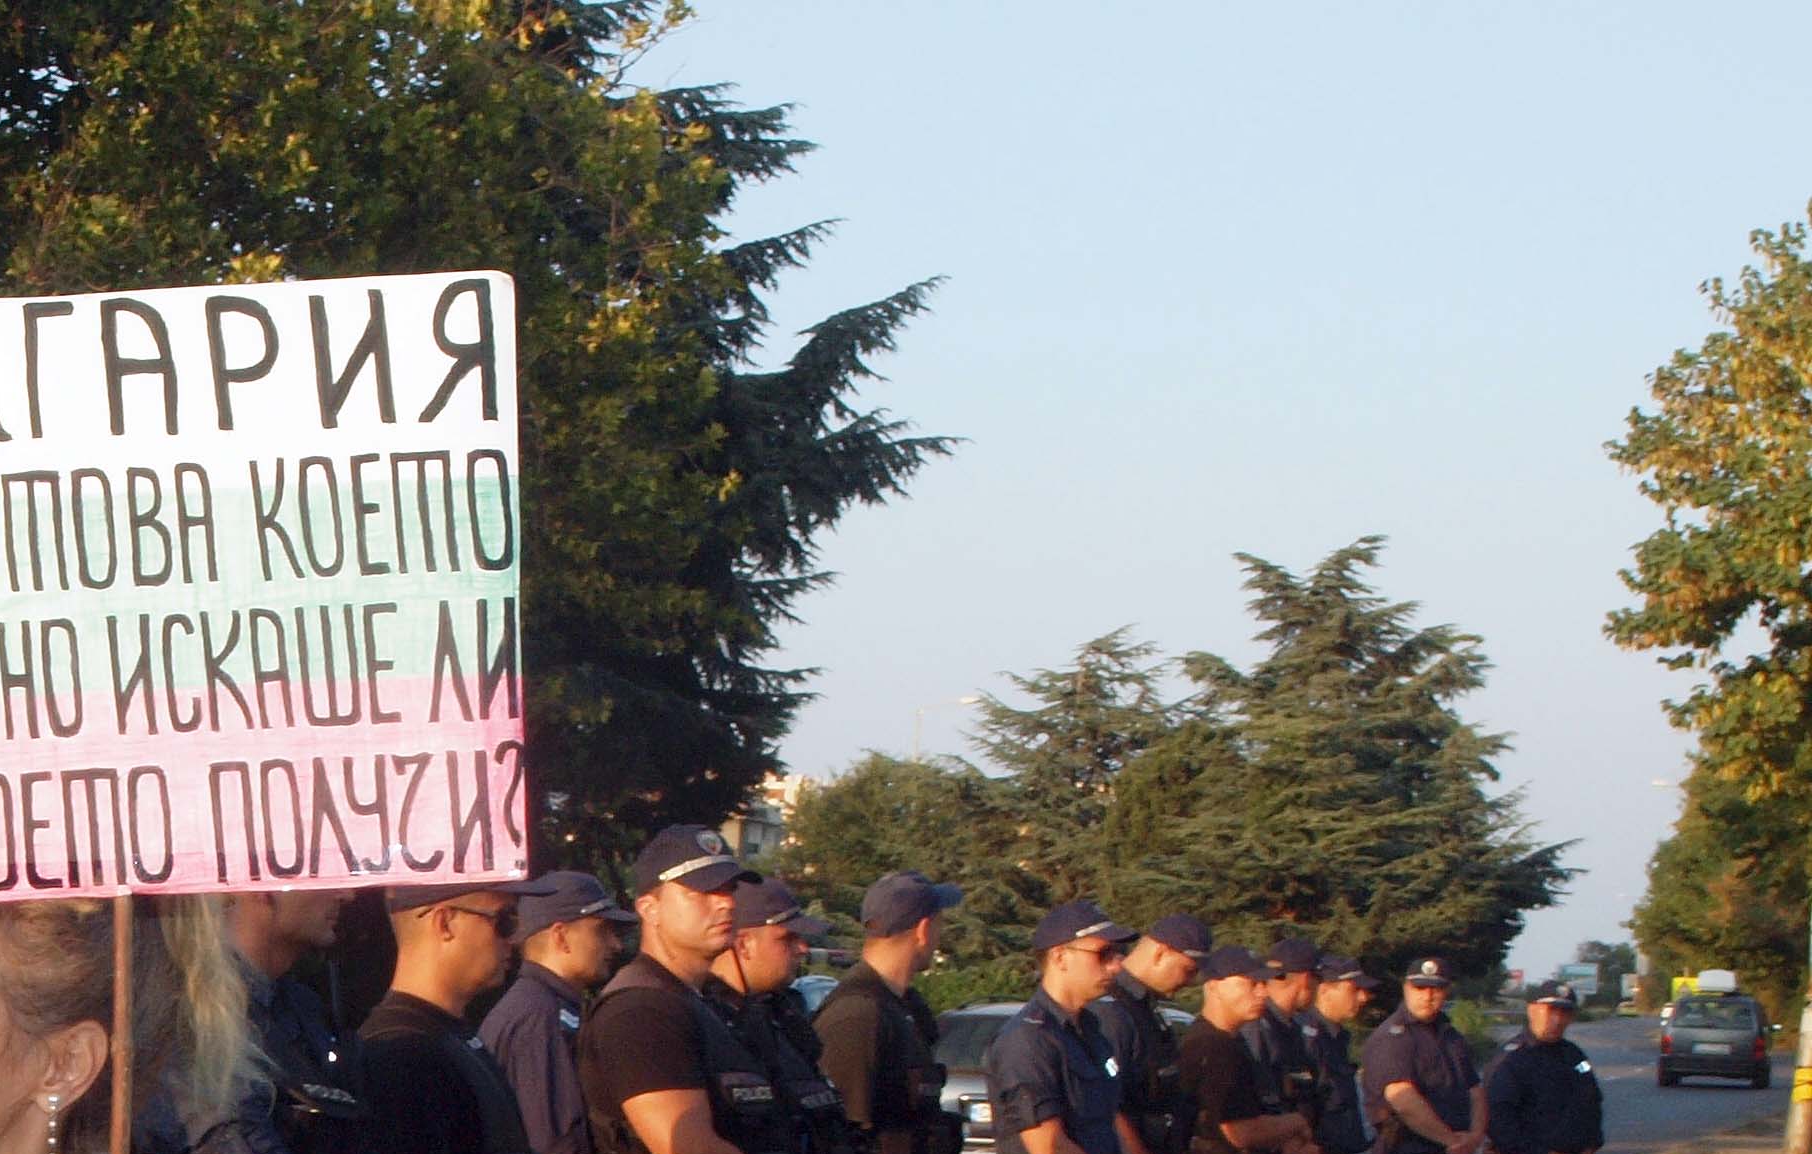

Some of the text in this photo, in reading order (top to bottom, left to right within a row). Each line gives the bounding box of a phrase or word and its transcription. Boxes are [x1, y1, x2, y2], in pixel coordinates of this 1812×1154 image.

[1, 463, 218, 592] ТОВА
[249, 449, 514, 582] КОЕТО
[105, 602, 402, 732] ИСКАШЕ
[429, 597, 520, 722] ЛИ
[208, 739, 526, 886] ПОЛУЧИ?
